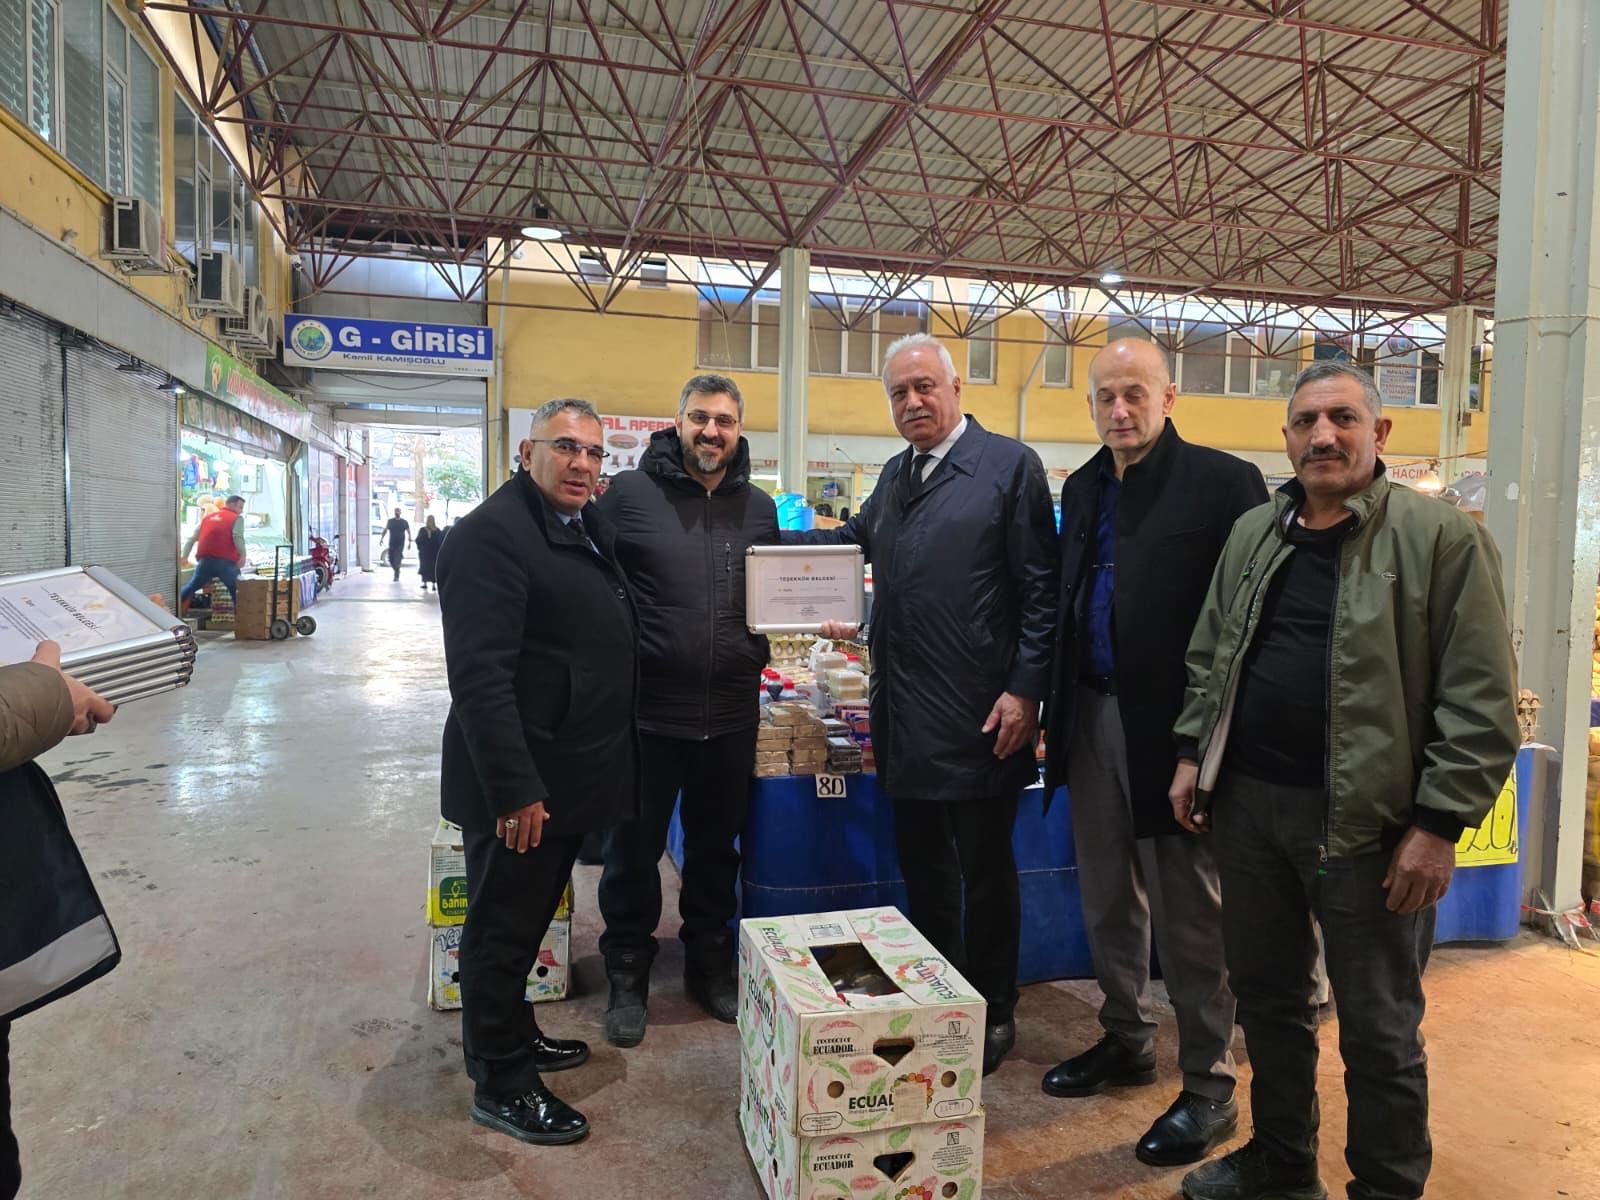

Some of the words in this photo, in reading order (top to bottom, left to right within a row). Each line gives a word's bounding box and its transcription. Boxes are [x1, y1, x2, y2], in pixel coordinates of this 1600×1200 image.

[339, 326, 361, 348] G
[390, 326, 486, 358] GİRİŞİ
[813, 1044, 853, 1056] ECUADOR
[813, 1160, 854, 1171] ECUADOR
